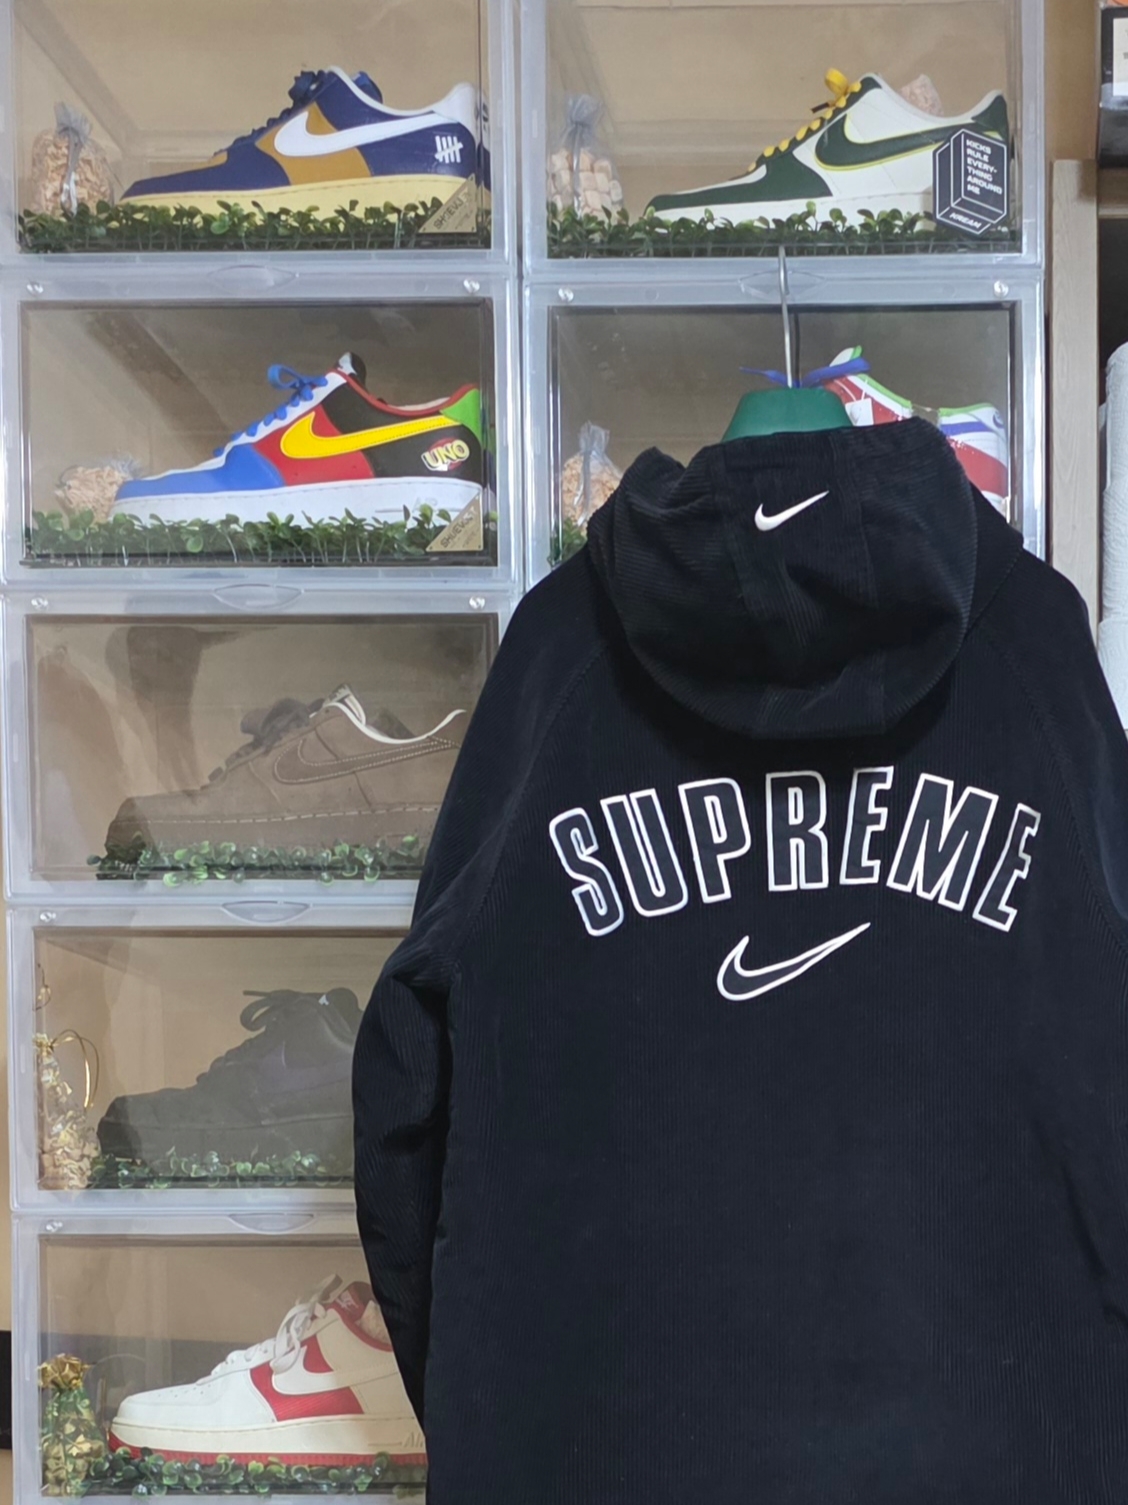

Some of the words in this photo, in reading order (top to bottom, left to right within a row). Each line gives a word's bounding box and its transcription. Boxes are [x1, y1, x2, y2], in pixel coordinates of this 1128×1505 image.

[966, 139, 991, 154] KICKS
[966, 148, 989, 162] RULE
[967, 157, 997, 173] EVERY-
[967, 166, 993, 182] THING
[967, 175, 1003, 195] AROUND
[967, 184, 980, 195] ME
[421, 439, 470, 471] UNO
[549, 766, 1041, 936] SUPREME
